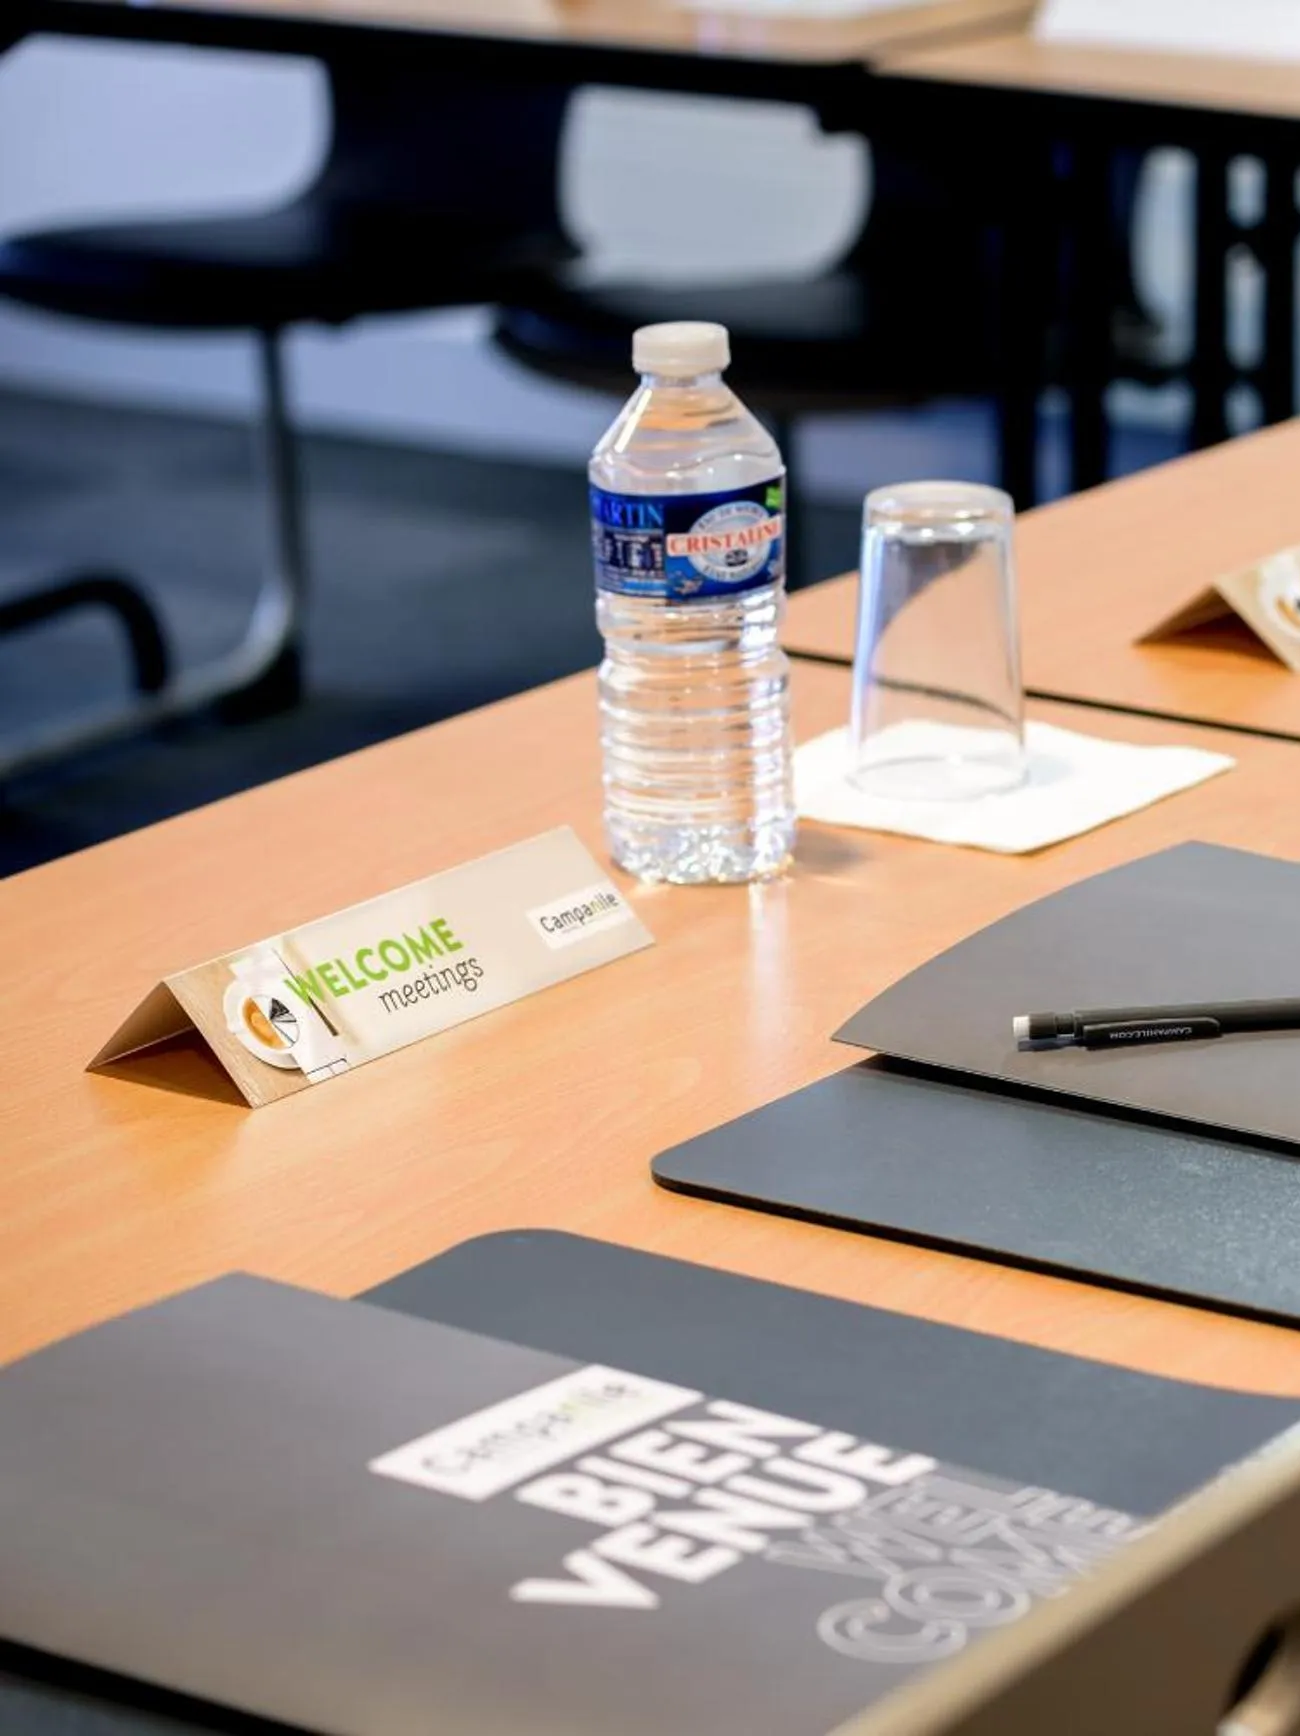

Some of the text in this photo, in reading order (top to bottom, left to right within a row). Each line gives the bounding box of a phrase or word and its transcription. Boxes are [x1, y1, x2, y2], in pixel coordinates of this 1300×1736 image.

[540, 892, 620, 934] Campanile
[283, 918, 463, 1008] WELCOME
[378, 956, 484, 1014] meetings
[513, 1399, 823, 1526] BIEN
[509, 1431, 938, 1610] VENUE
